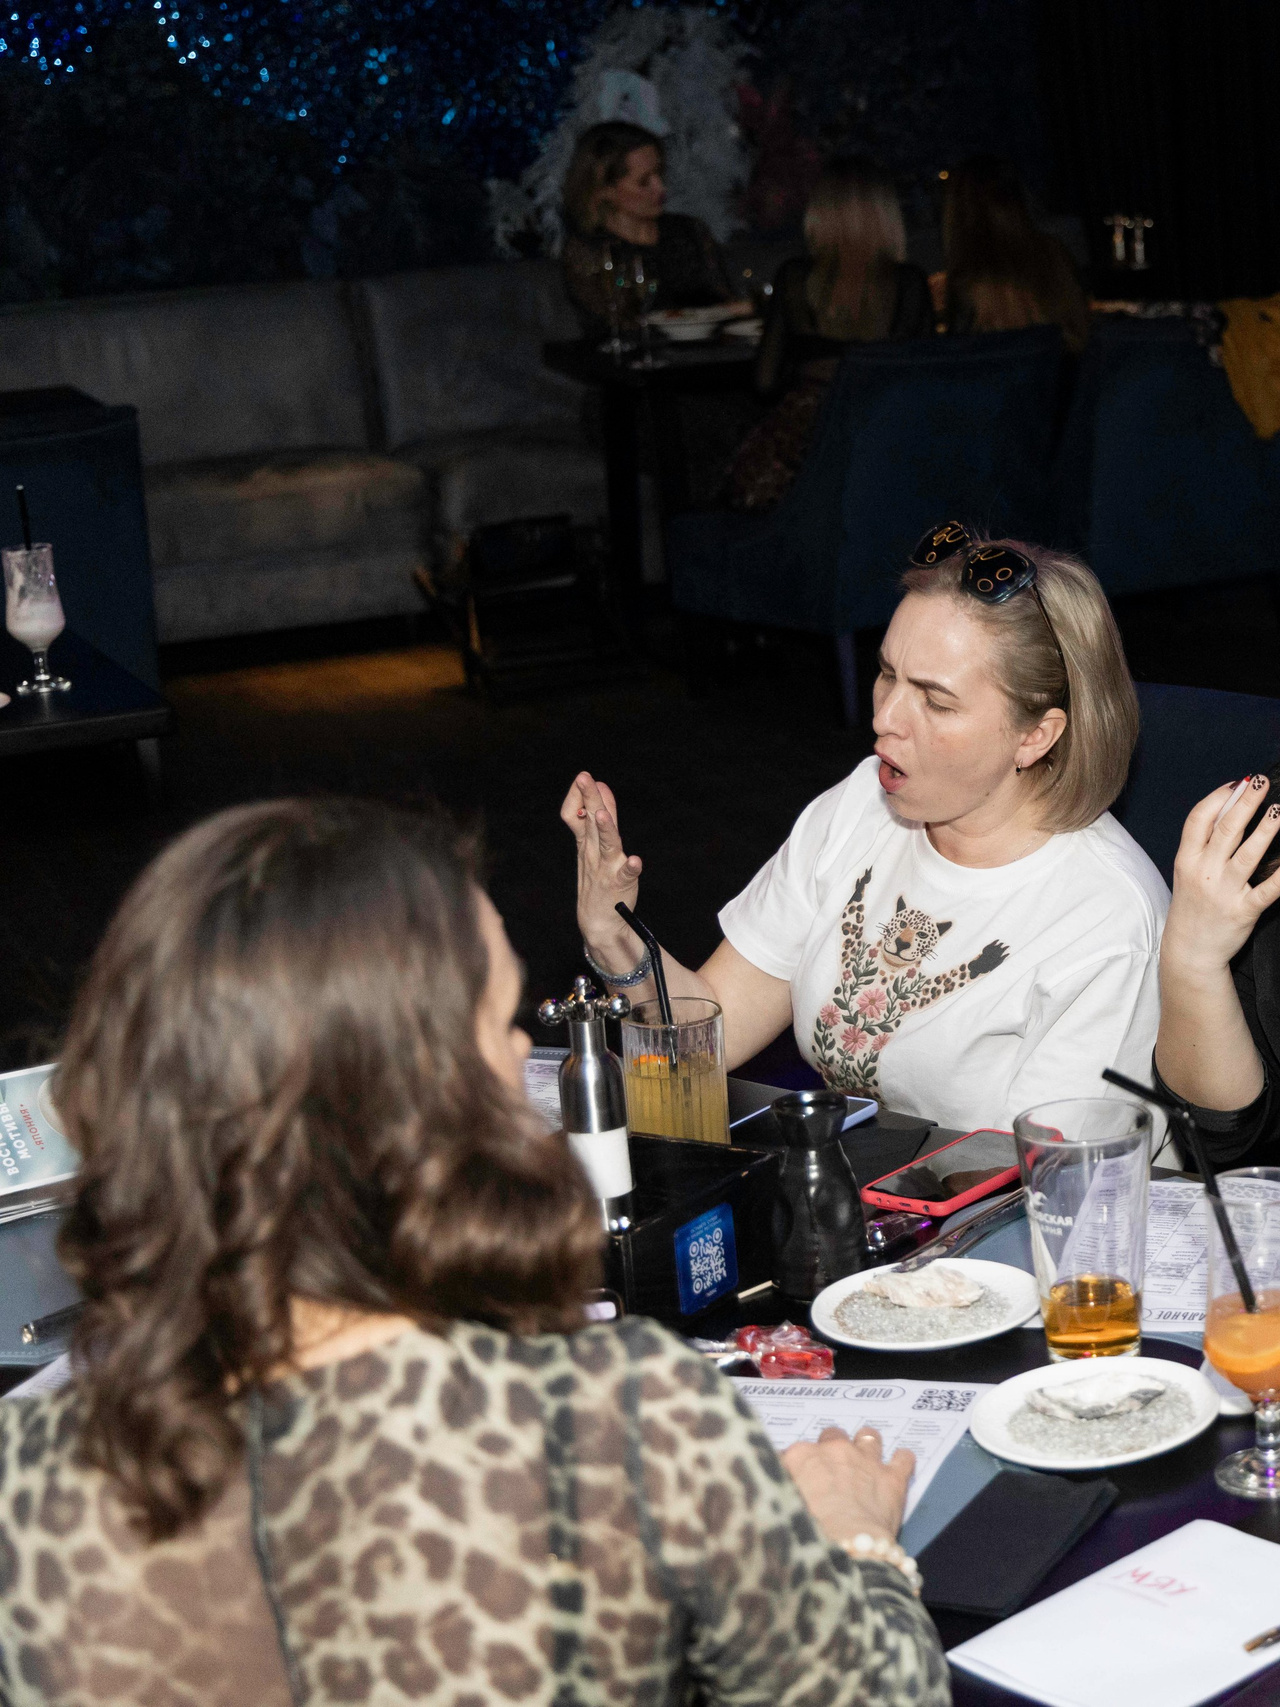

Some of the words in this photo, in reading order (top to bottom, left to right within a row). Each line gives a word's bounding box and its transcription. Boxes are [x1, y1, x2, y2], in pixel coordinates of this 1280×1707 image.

[0, 1103, 32, 1159] МОТИВЫ
[19, 1108, 44, 1146] ЯПОНИЯ
[1155, 1310, 1206, 1321] АЛЬНОЕ
[739, 1384, 841, 1397] МУЗЫКАЛЬНОЕ
[855, 1387, 893, 1399] ЛОТО
